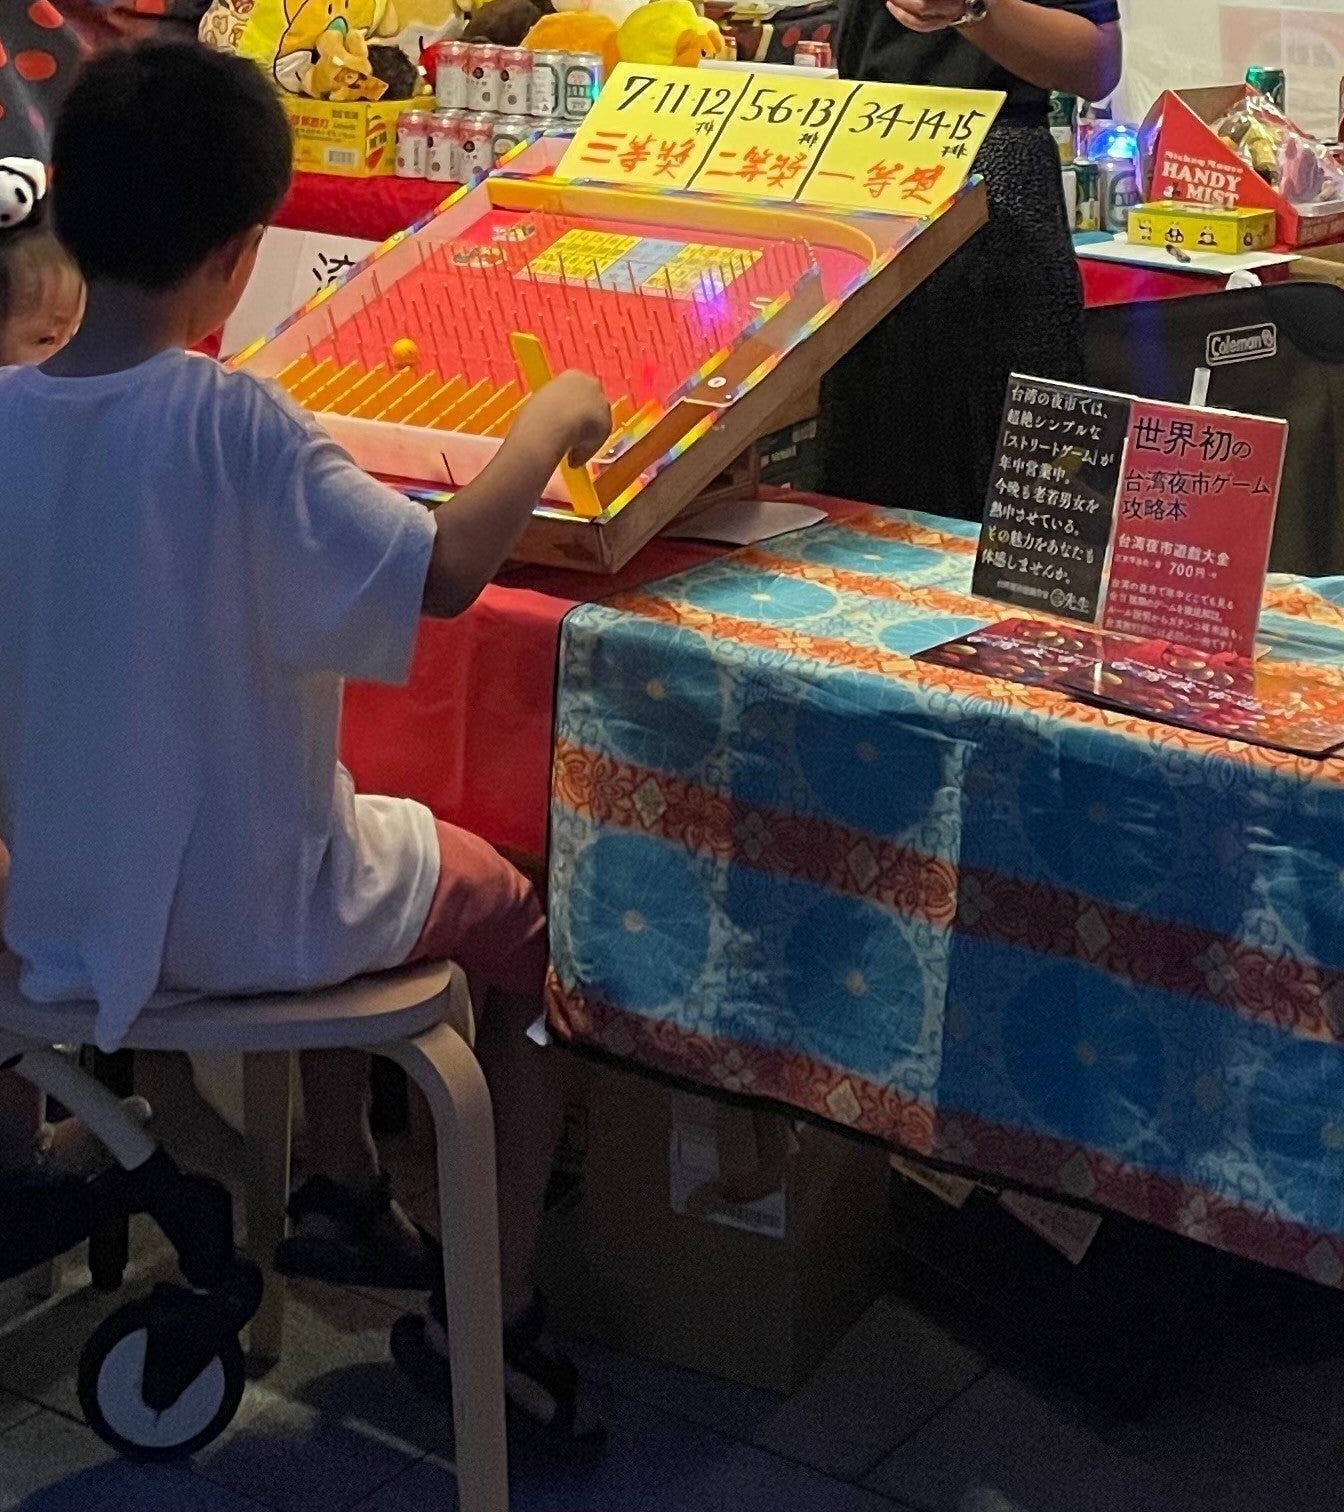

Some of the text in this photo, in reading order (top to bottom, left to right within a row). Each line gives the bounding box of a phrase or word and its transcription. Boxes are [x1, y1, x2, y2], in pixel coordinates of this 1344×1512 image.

[1161, 161, 1243, 191] HANDY
[1185, 184, 1240, 207] MIST
[1210, 331, 1264, 360] Coleman
[1133, 417, 1253, 463] 世界初の
[1124, 469, 1271, 497] 台湾夜市ゲーム
[1121, 497, 1188, 522] 攻略本
